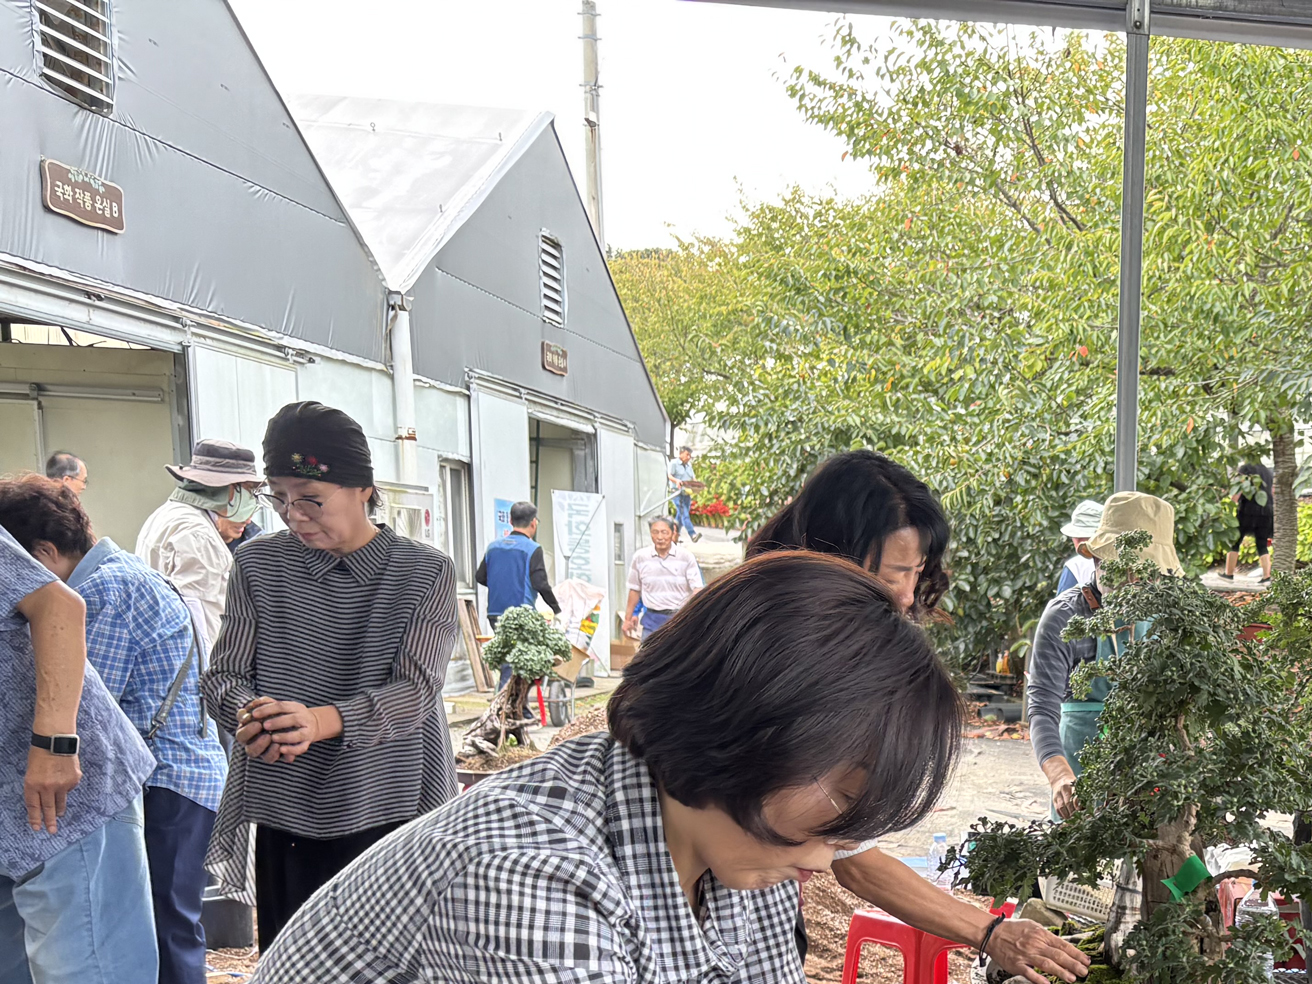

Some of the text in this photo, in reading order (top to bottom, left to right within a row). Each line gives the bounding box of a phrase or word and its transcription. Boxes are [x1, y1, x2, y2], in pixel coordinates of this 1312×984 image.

[54, 180, 119, 218] 국화 작품 온실 B
